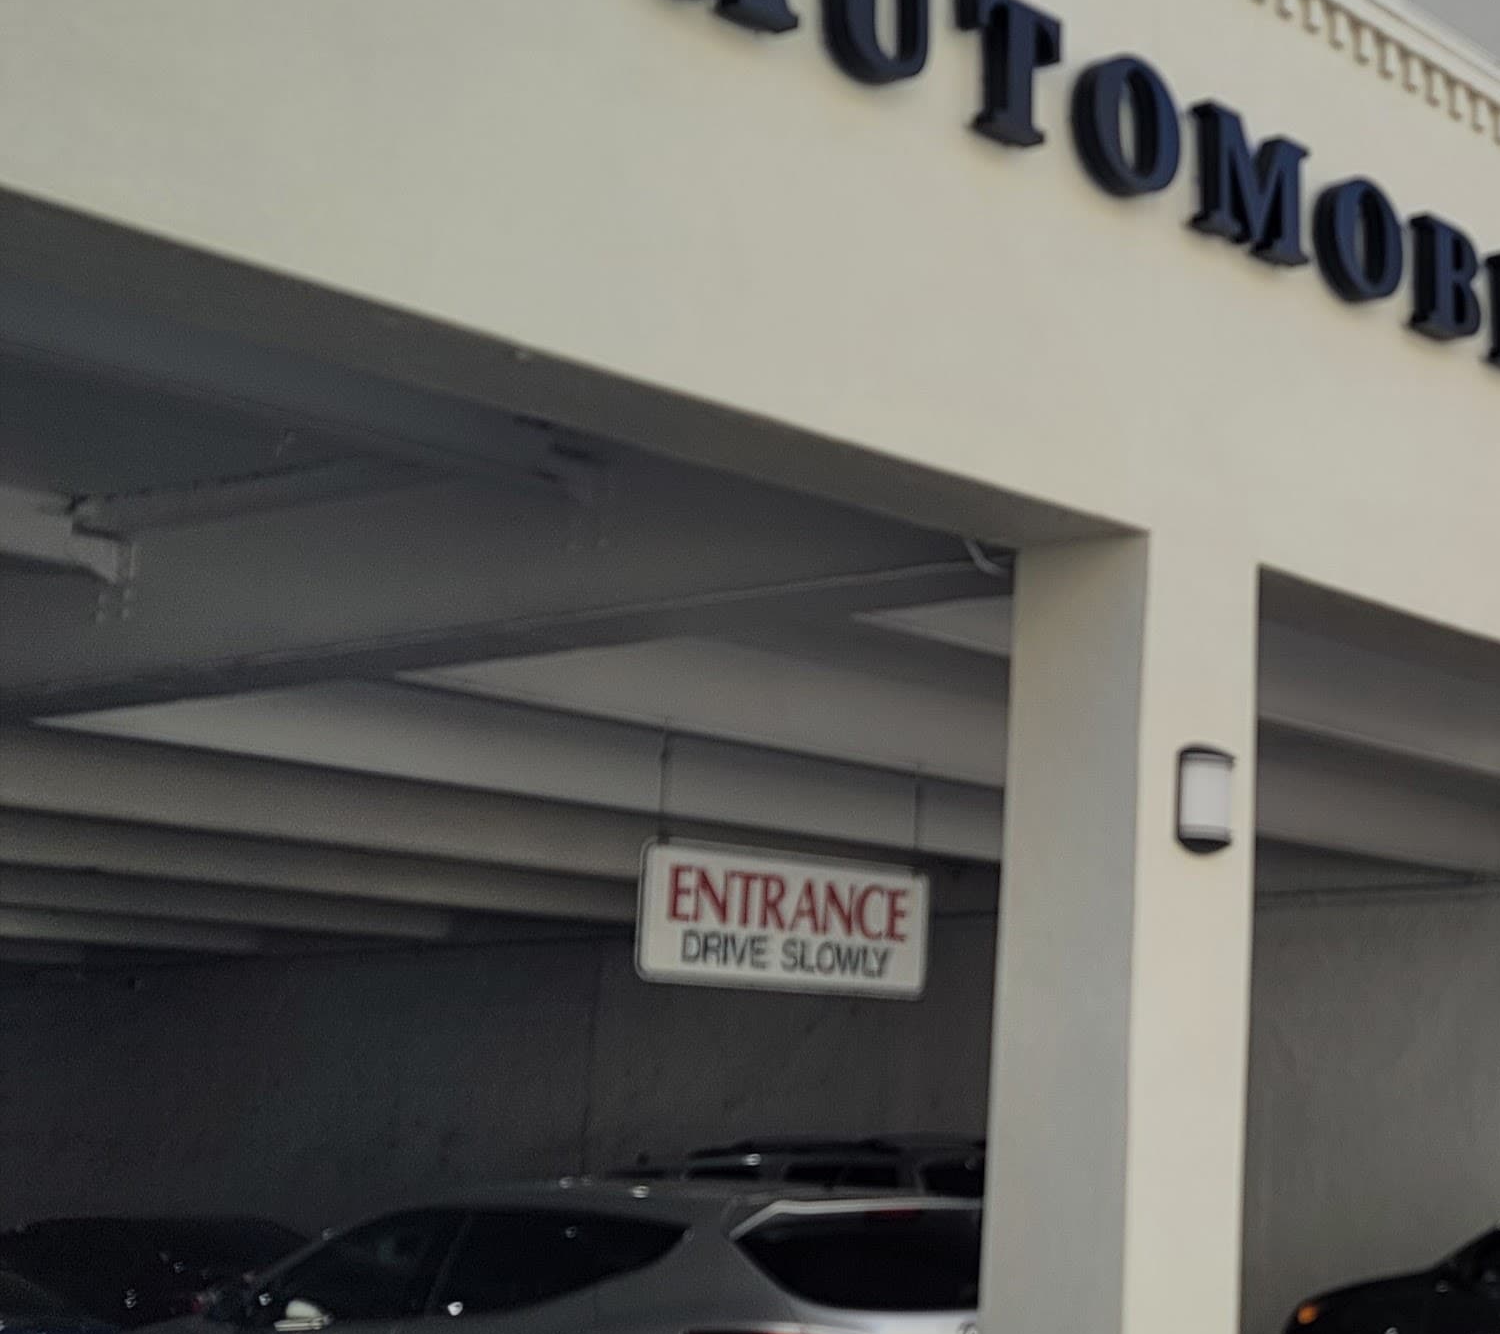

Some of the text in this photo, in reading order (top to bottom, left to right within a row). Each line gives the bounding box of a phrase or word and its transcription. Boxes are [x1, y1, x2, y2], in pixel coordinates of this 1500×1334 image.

[667, 863, 907, 943] ENTRANCE
[681, 928, 892, 979] DRIVE SLOWLY
